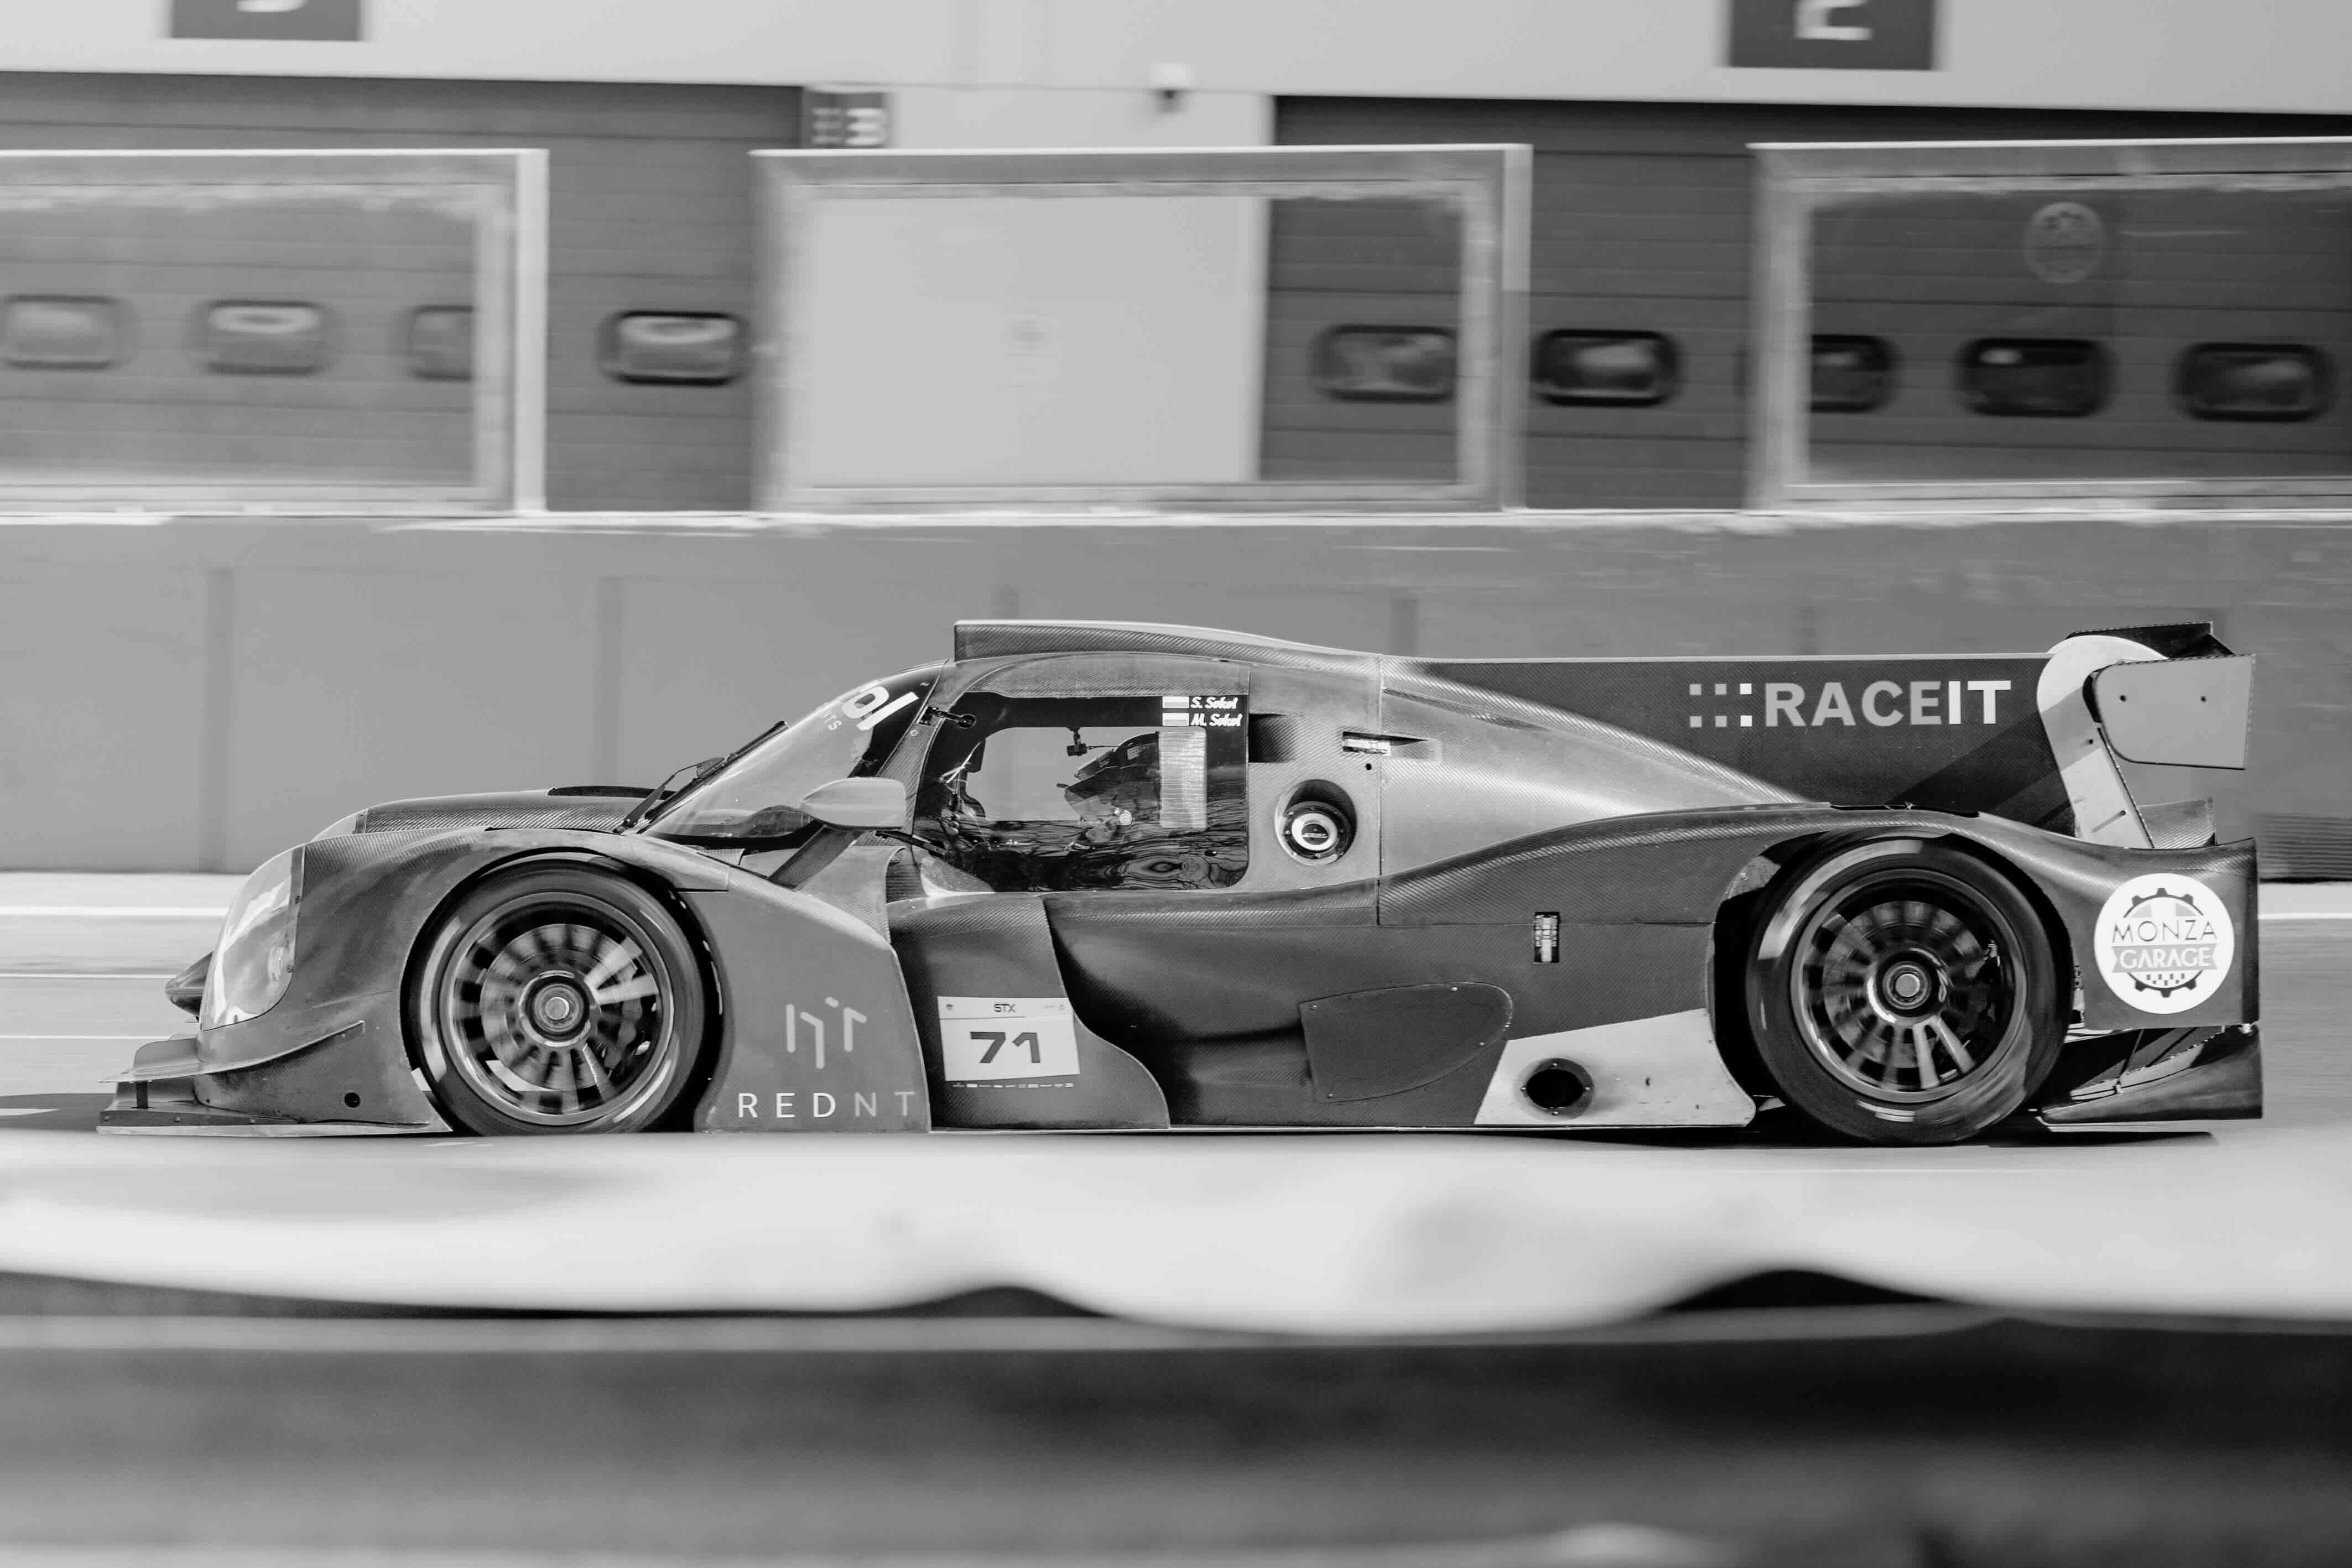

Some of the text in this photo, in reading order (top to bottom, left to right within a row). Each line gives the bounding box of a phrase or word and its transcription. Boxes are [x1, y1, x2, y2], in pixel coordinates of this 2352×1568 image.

[1204, 696, 1239, 709] Sokol
[1765, 680, 2012, 727] RACEIT
[1209, 713, 1243, 727] Sokol
[2112, 919, 2218, 944] MONZA
[2119, 946, 2211, 970] GARAGE
[970, 1031, 1041, 1064] 71
